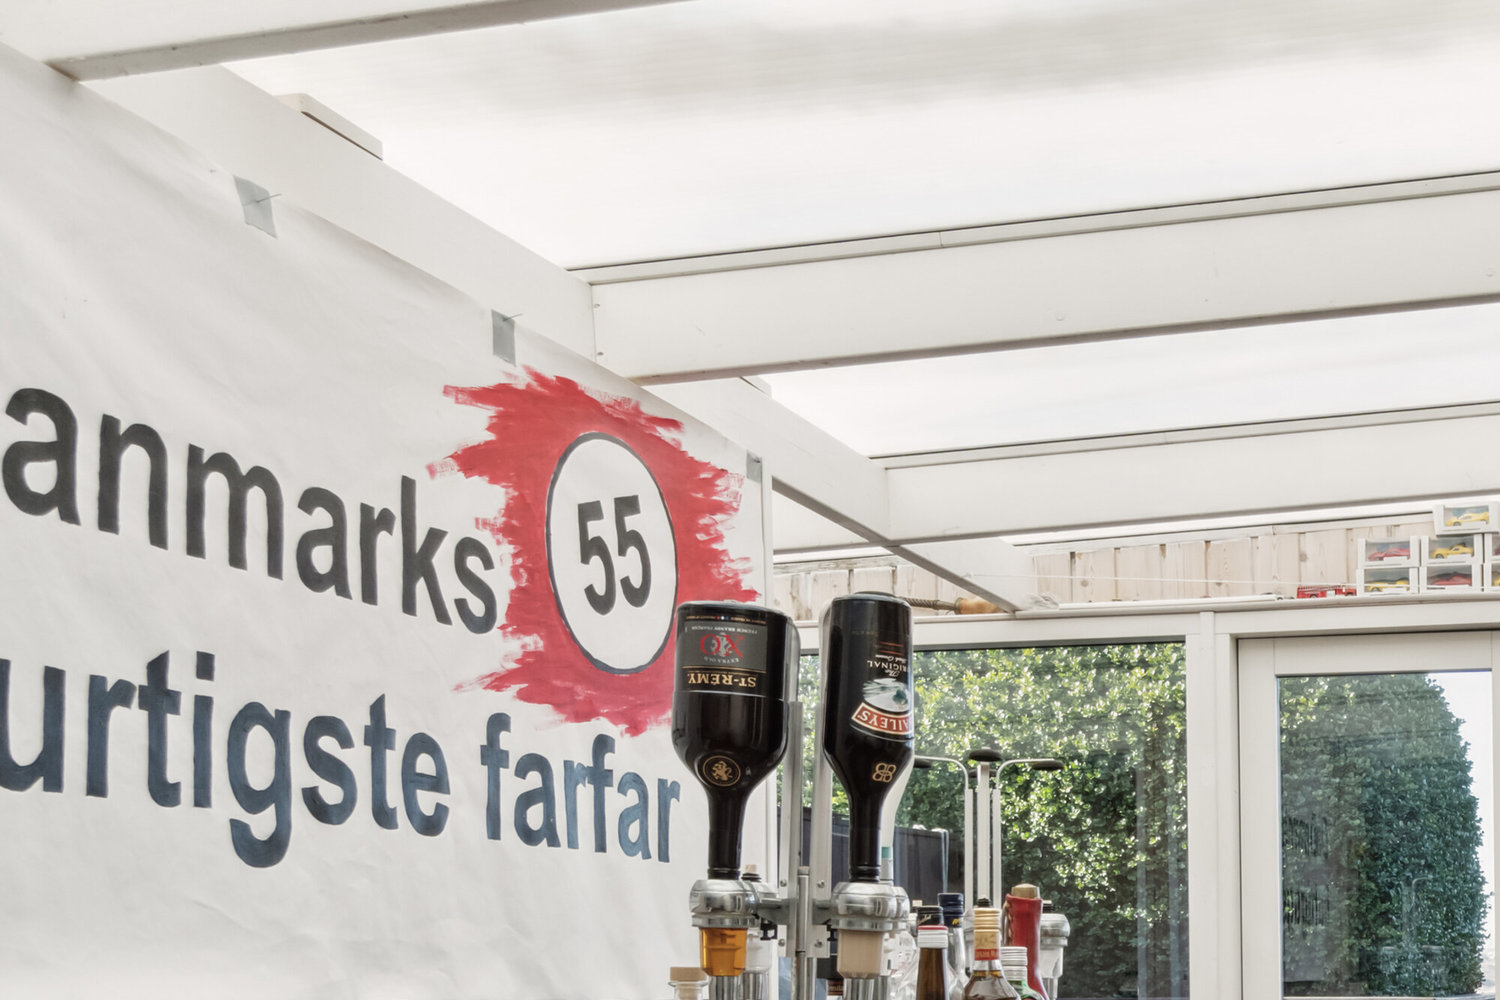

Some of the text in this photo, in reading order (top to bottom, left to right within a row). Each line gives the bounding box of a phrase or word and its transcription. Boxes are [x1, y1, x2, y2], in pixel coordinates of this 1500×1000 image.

[2, 387, 499, 635] anmarks
[576, 494, 652, 616] 55
[700, 634, 745, 659] XO
[867, 660, 909, 671] RIGINAL
[860, 710, 912, 731] AILEYS
[480, 712, 681, 864] farfar
